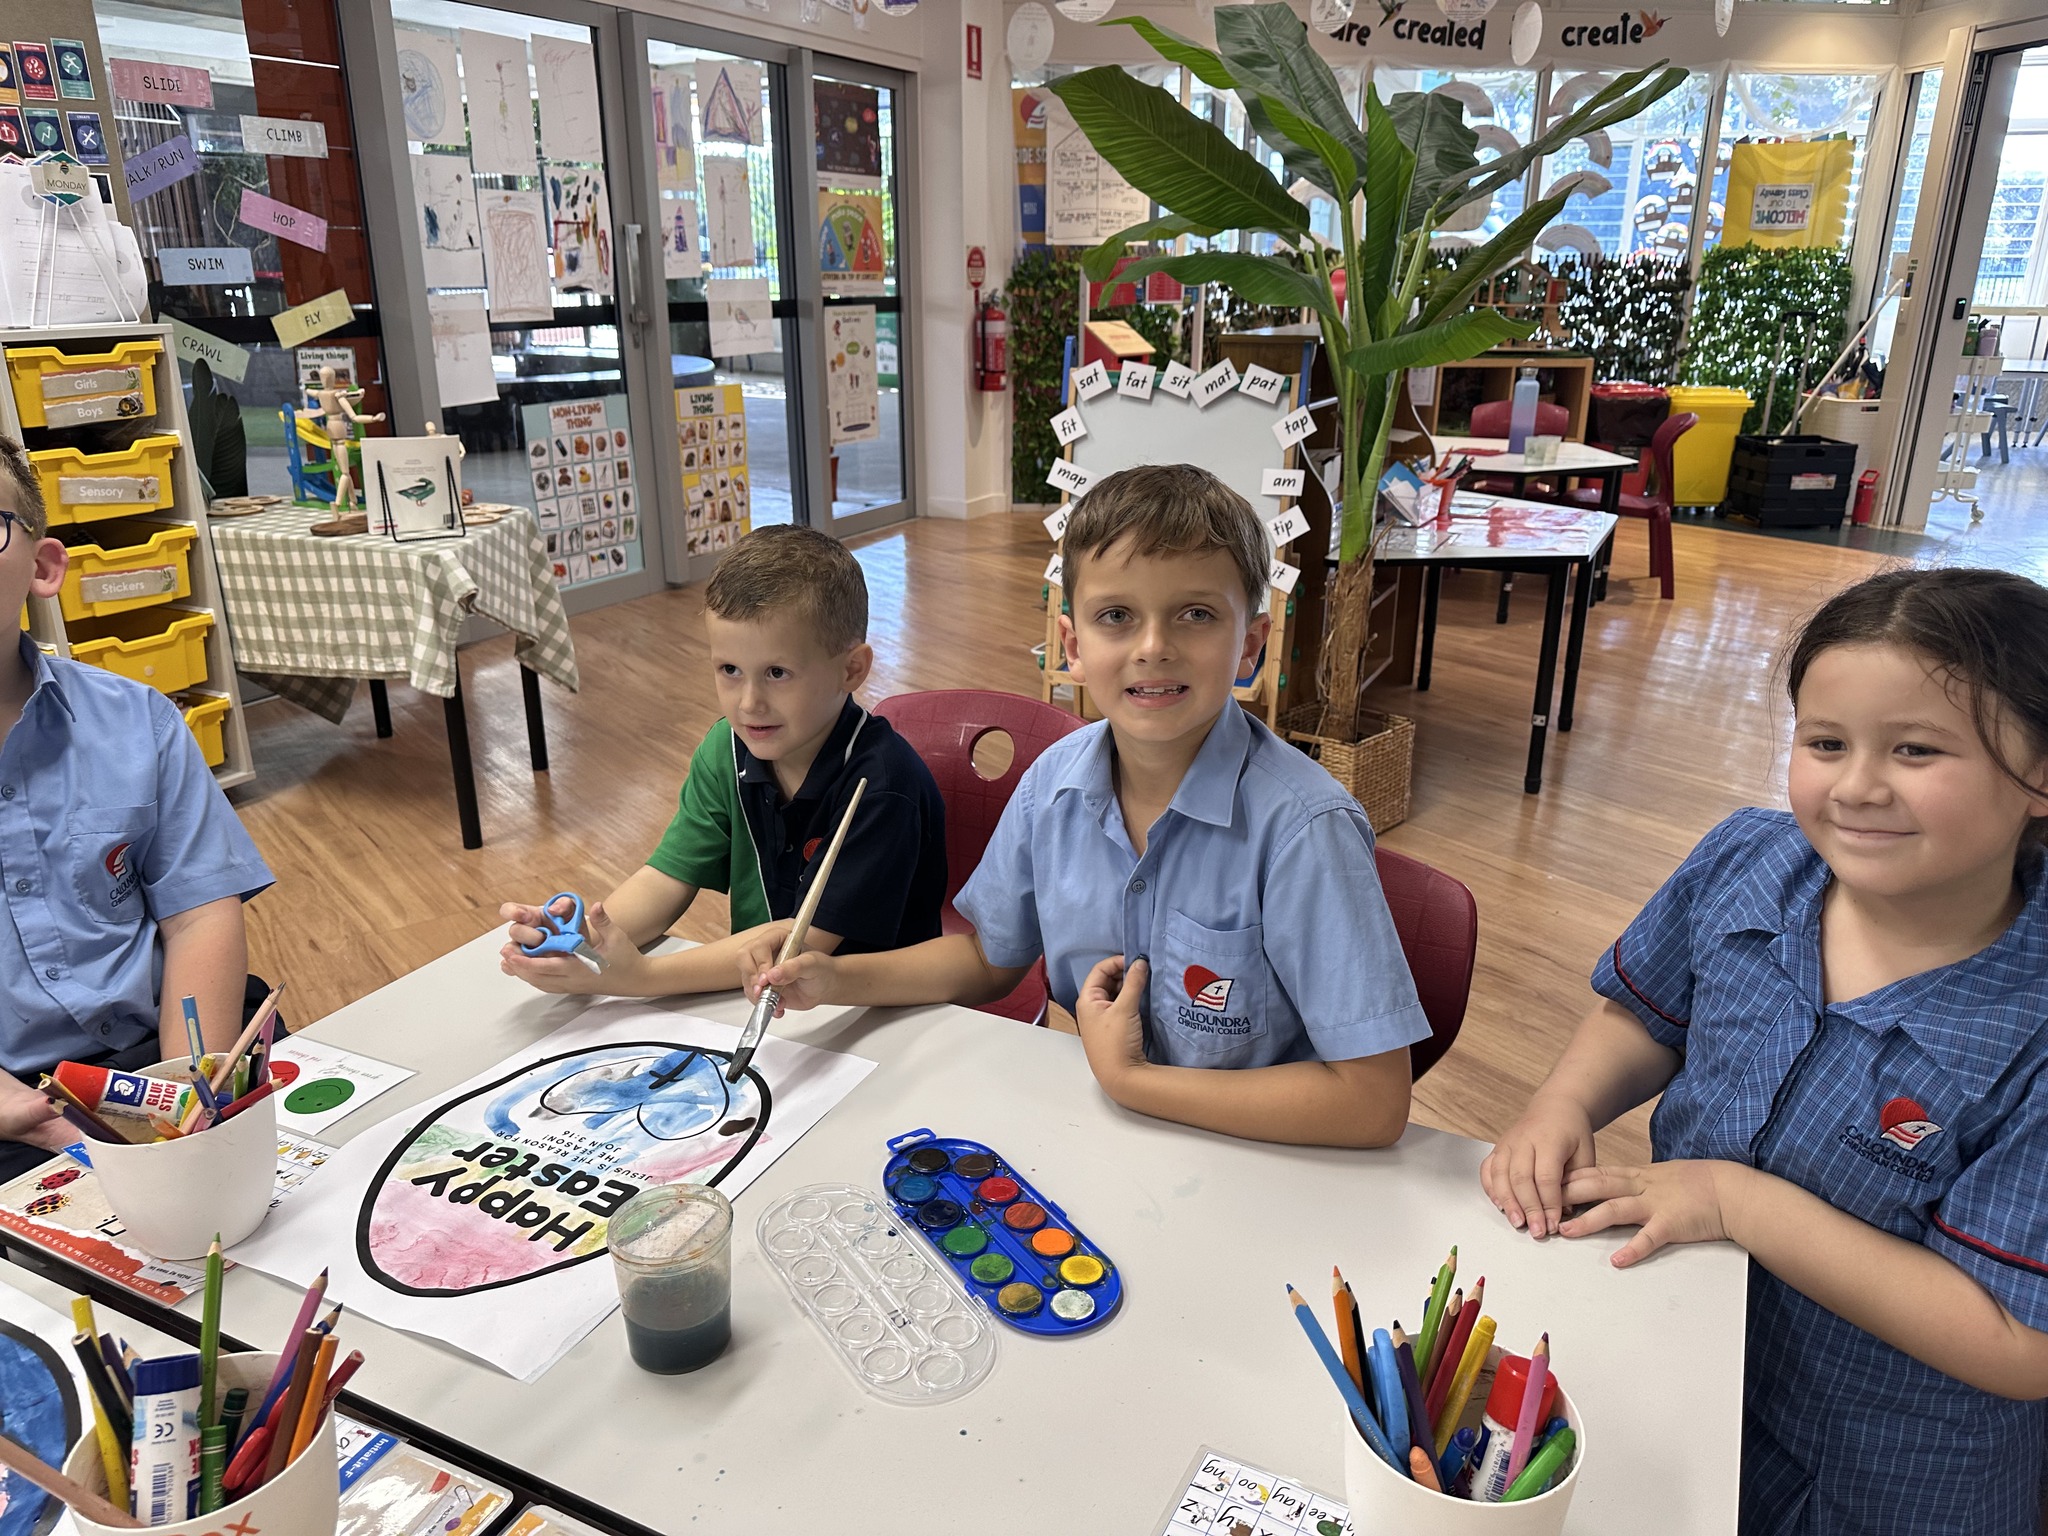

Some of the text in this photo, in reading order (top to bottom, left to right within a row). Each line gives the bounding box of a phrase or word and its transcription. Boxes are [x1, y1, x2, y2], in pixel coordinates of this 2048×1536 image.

[1562, 12, 1644, 47] create
[144, 76, 182, 92] SLIDE
[266, 128, 302, 142] CLIMB
[46, 179, 86, 190] MONDAY
[273, 212, 296, 227] HOP
[1755, 210, 1806, 224] WELCOME
[188, 257, 224, 270] SWIM
[305, 311, 321, 327] FLY
[182, 336, 222, 362] CRAWL
[300, 352, 349, 361] Living things
[74, 378, 98, 390] Girls
[1079, 368, 1100, 389] sat
[1126, 372, 1148, 389] fat
[1170, 374, 1191, 389] sit
[1204, 367, 1232, 394] mat
[1248, 375, 1277, 392] pat
[690, 393, 714, 404] LIVING
[77, 406, 104, 420] Boys
[552, 402, 602, 418] NON-LIVING
[692, 404, 714, 414] THING
[566, 416, 592, 430] THING
[1061, 418, 1078, 436] fit
[1284, 415, 1308, 435] tap
[1056, 466, 1088, 486] map
[1273, 476, 1296, 488] am
[79, 485, 124, 499] Sensory
[1274, 518, 1293, 536] tip
[102, 581, 144, 594] Stickers
[1178, 1006, 1251, 1028] CALOUNDRA
[1178, 1016, 1252, 1035] CHRISTIAN COLLEGE
[146, 1082, 164, 1106] GLUE
[158, 1083, 178, 1112] STICK
[542, 1134, 620, 1164] THE SEASON!
[562, 1130, 622, 1152] JOHN 3:16
[1845, 1125, 1936, 1174] CALOUNDRA
[496, 1130, 654, 1182] JESUS IS THE REASON FOR
[452, 1142, 640, 1218] Easter
[411, 1167, 595, 1252] Happy
[1202, 1459, 1226, 1480] ng
[1238, 1478, 1258, 1490] oo
[1272, 1486, 1296, 1507] ay
[1180, 1498, 1200, 1513] z
[1308, 1508, 1328, 1520] ee
[1216, 1506, 1244, 1528] y
